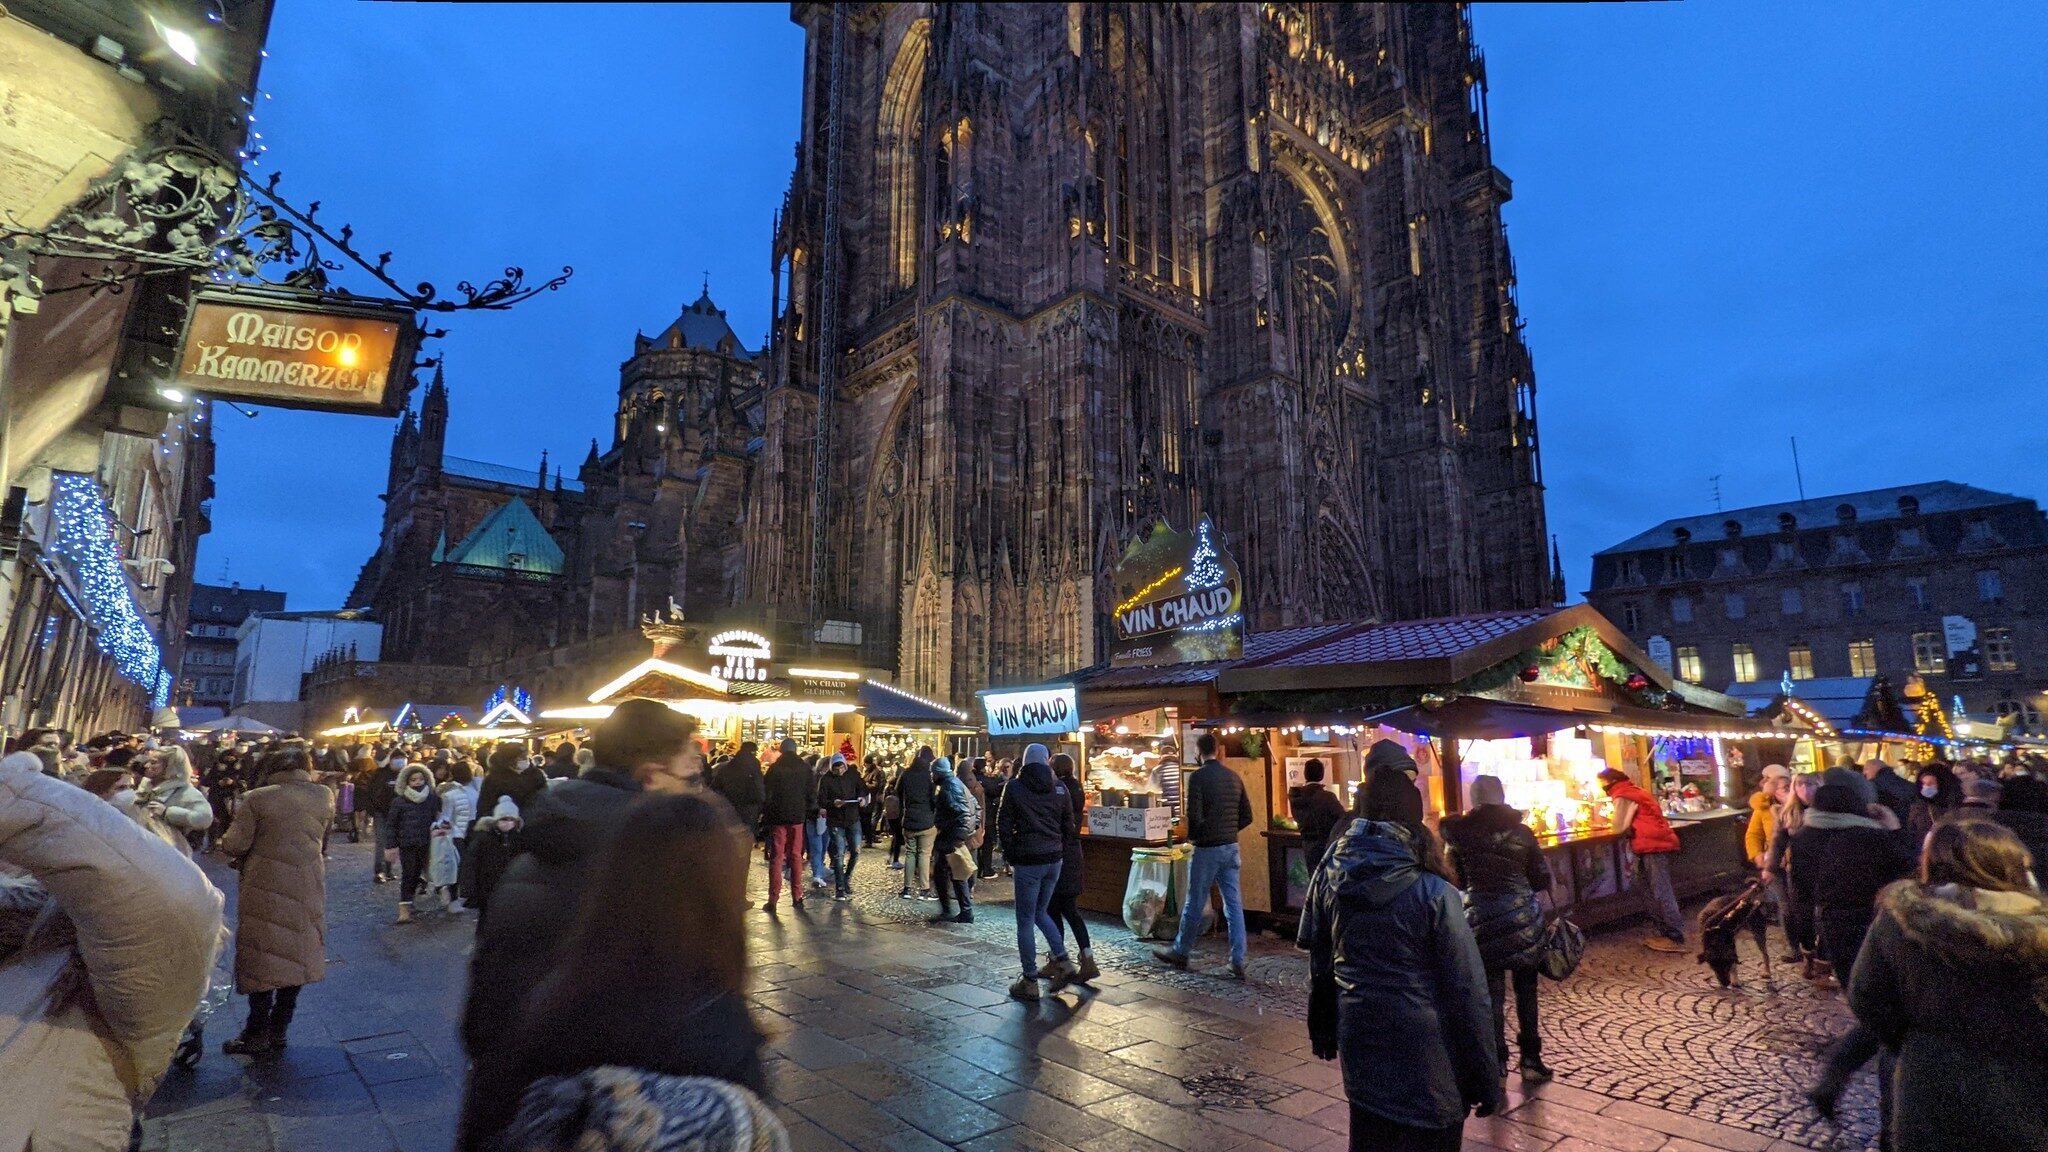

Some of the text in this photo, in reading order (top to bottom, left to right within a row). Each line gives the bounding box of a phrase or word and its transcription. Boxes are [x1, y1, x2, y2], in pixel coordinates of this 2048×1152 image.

[1121, 586, 1233, 634] VIN CHAUD
[726, 656, 755, 669] VIN
[711, 665, 767, 681] CHAUD
[803, 679, 846, 688] VIN CHAUD
[803, 688, 846, 697] GLÜHWEIN
[994, 697, 1067, 730] VIN CHAUD
